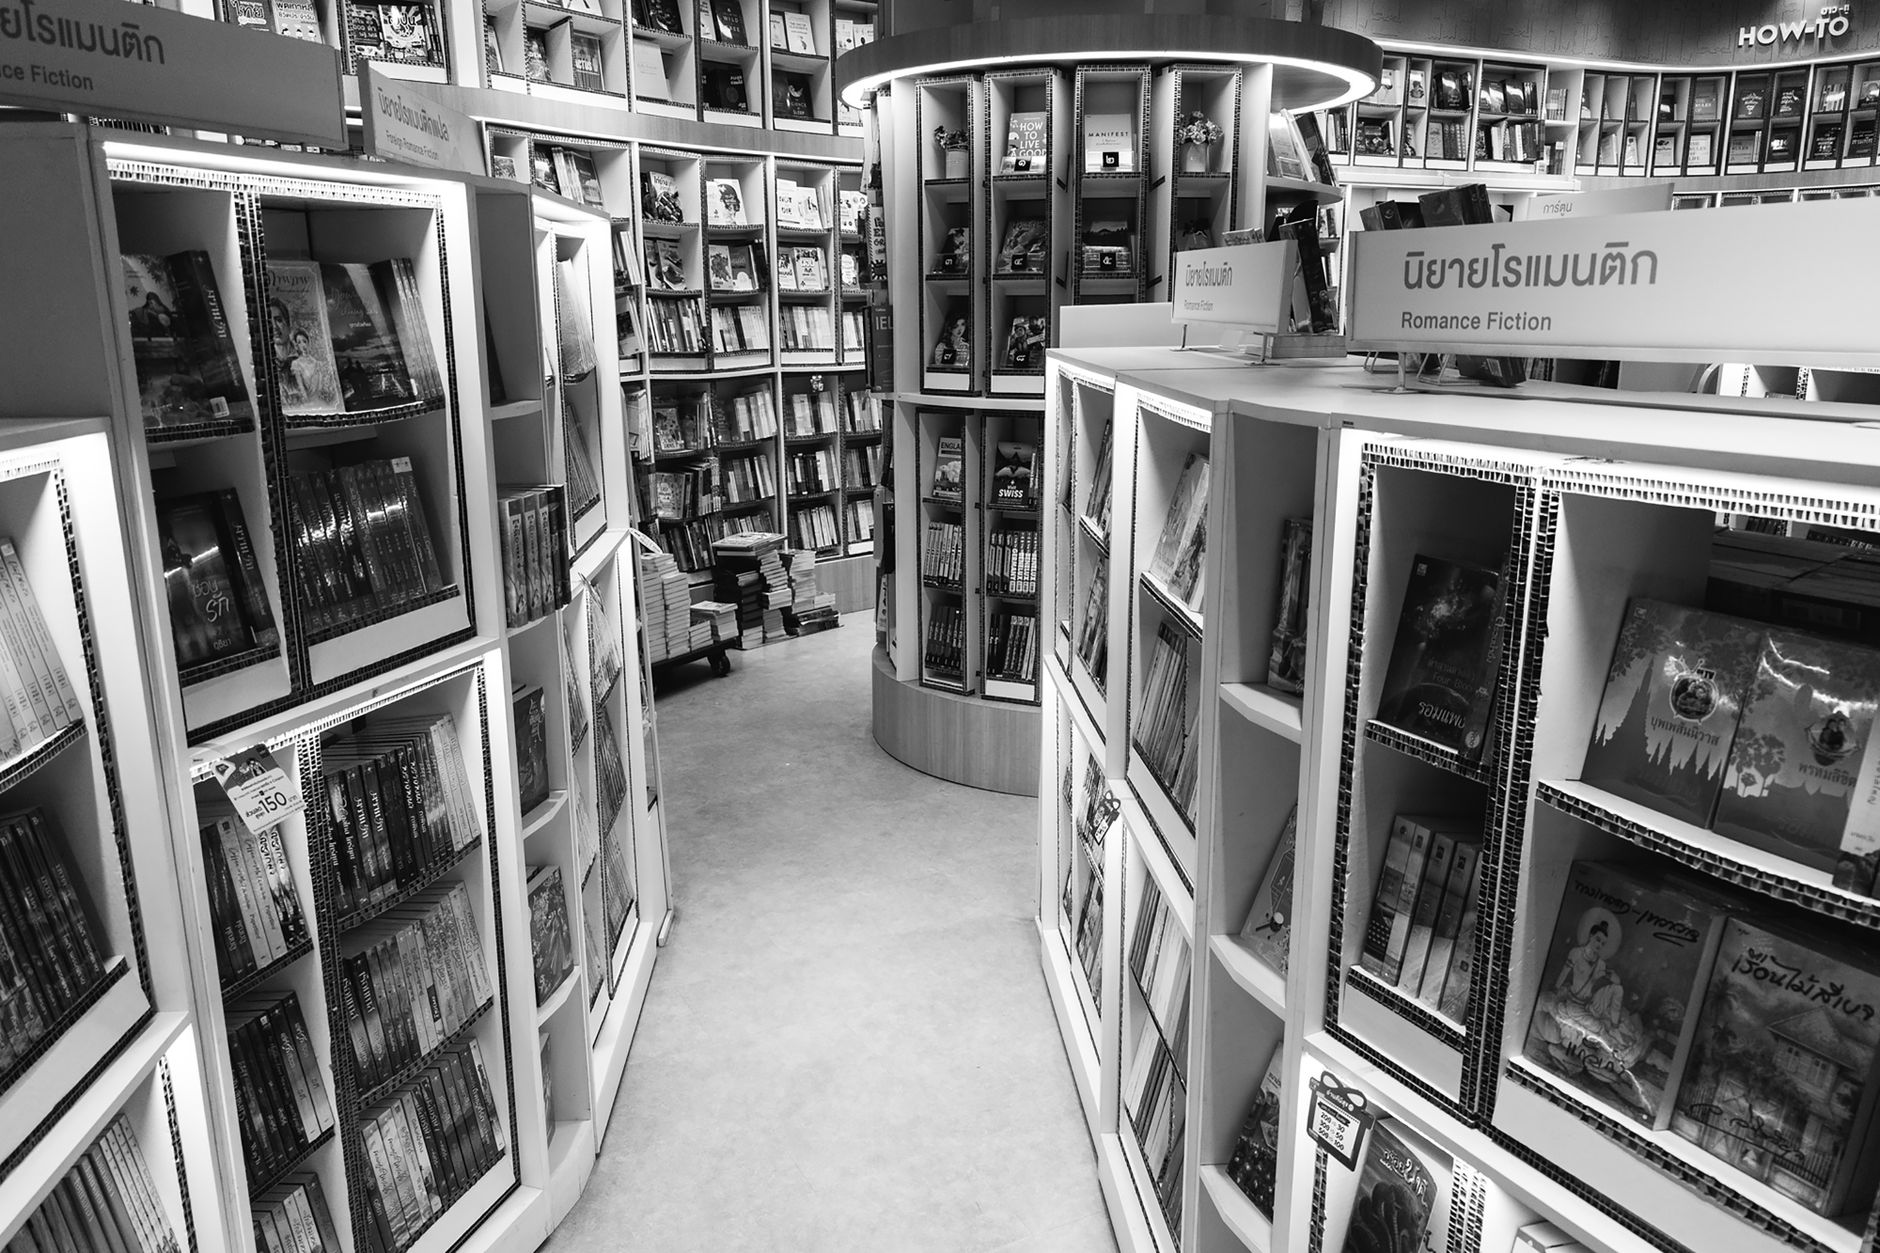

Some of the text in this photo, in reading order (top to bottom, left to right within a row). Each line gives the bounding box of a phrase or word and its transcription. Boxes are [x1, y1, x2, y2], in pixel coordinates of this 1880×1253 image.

[1738, 15, 1850, 48] HOW-TO
[31, 64, 94, 90] Fiction
[1020, 122, 1043, 131] HOW
[1021, 140, 1039, 148] LIVE
[1543, 200, 1572, 216] การ์ตูน
[1186, 261, 1232, 286] นิยายโรแมนติก
[1403, 241, 1658, 290] นิยายโรแมนติก
[1402, 311, 1552, 332] Romance Fiction
[206, 591, 229, 622] รัก
[258, 790, 288, 814] 150
[1731, 947, 1876, 1023] เรือนไม้สีเบจ
[1321, 1111, 1345, 1133] 200 30
[1318, 1127, 1345, 1151] 500 100
[1335, 1131, 1344, 1142] 50
